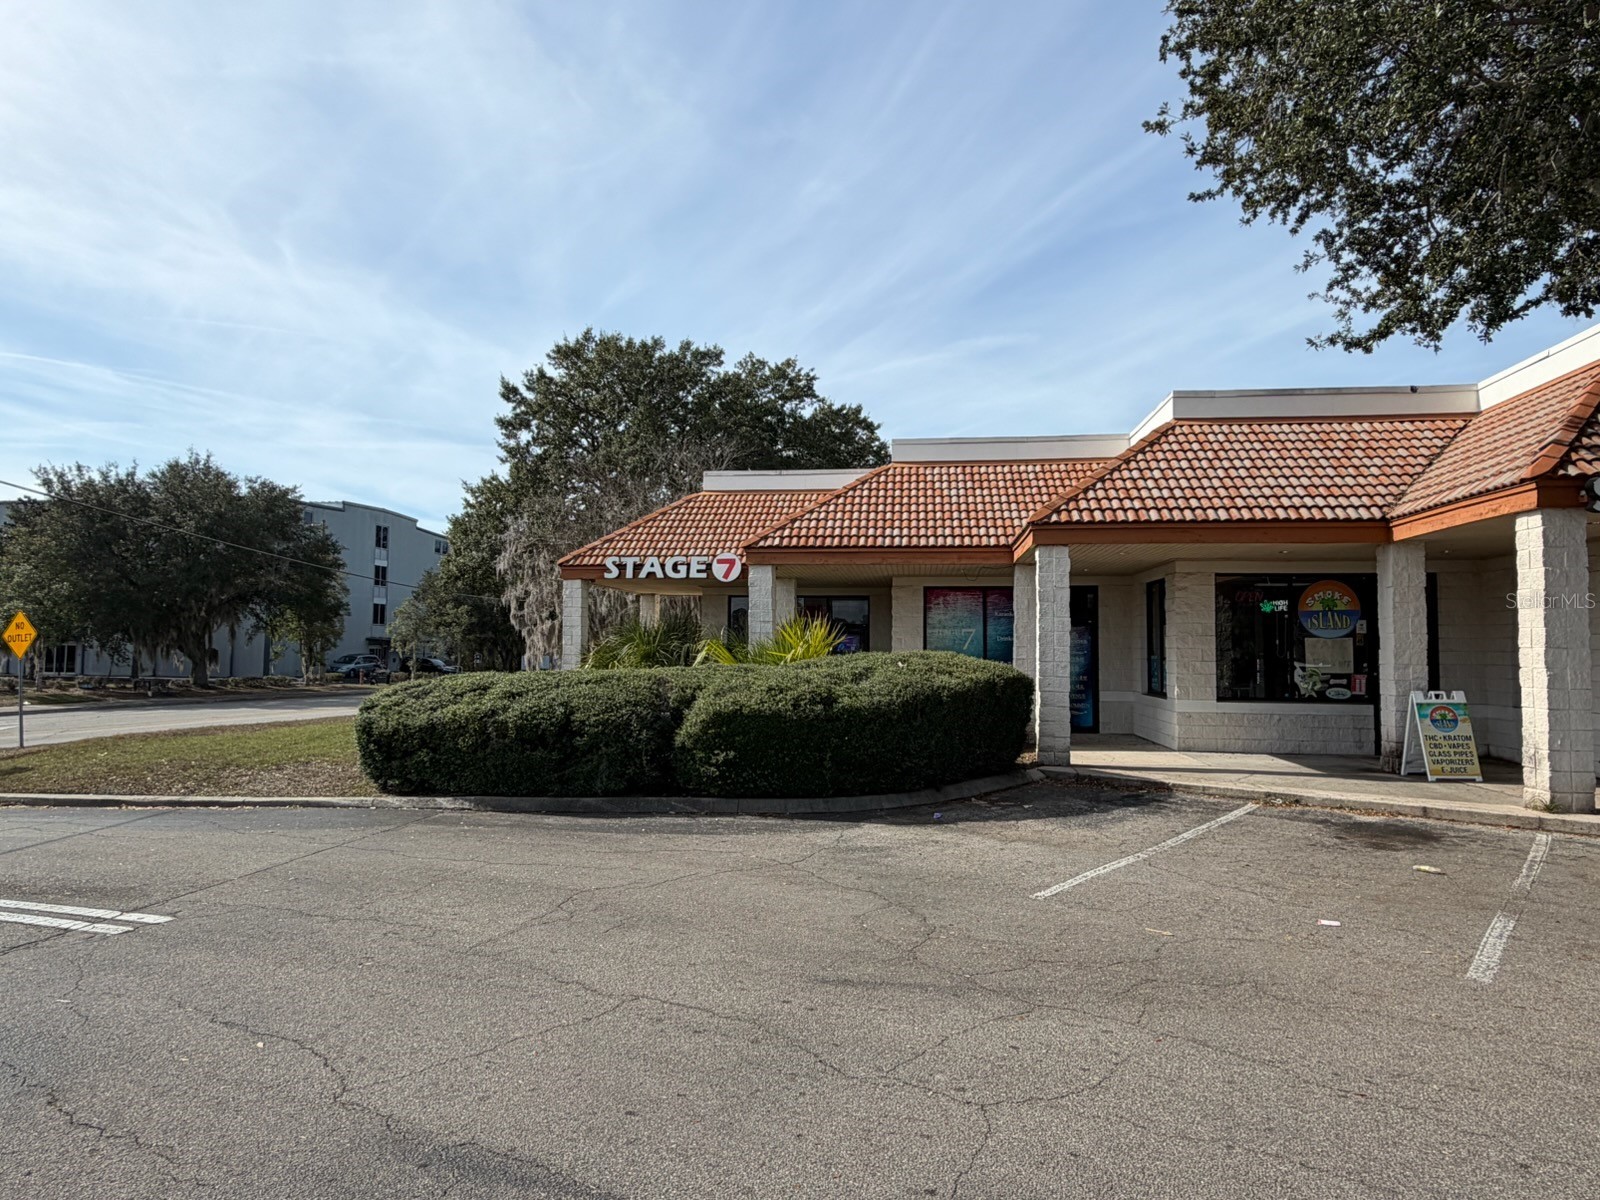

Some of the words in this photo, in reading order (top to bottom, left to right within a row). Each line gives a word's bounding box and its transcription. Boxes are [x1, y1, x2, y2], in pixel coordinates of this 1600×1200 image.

[603, 555, 709, 579] STAGE
[716, 558, 736, 581] 7
[1236, 591, 1264, 601] OPEN
[1305, 590, 1352, 607] SMOKE
[15, 622, 24, 630] NO
[1307, 611, 1351, 630] ISLAND
[8, 634, 32, 642] OUTLET
[961, 628, 976, 651] 7
[1431, 758, 1475, 766] VAPORIZERS
